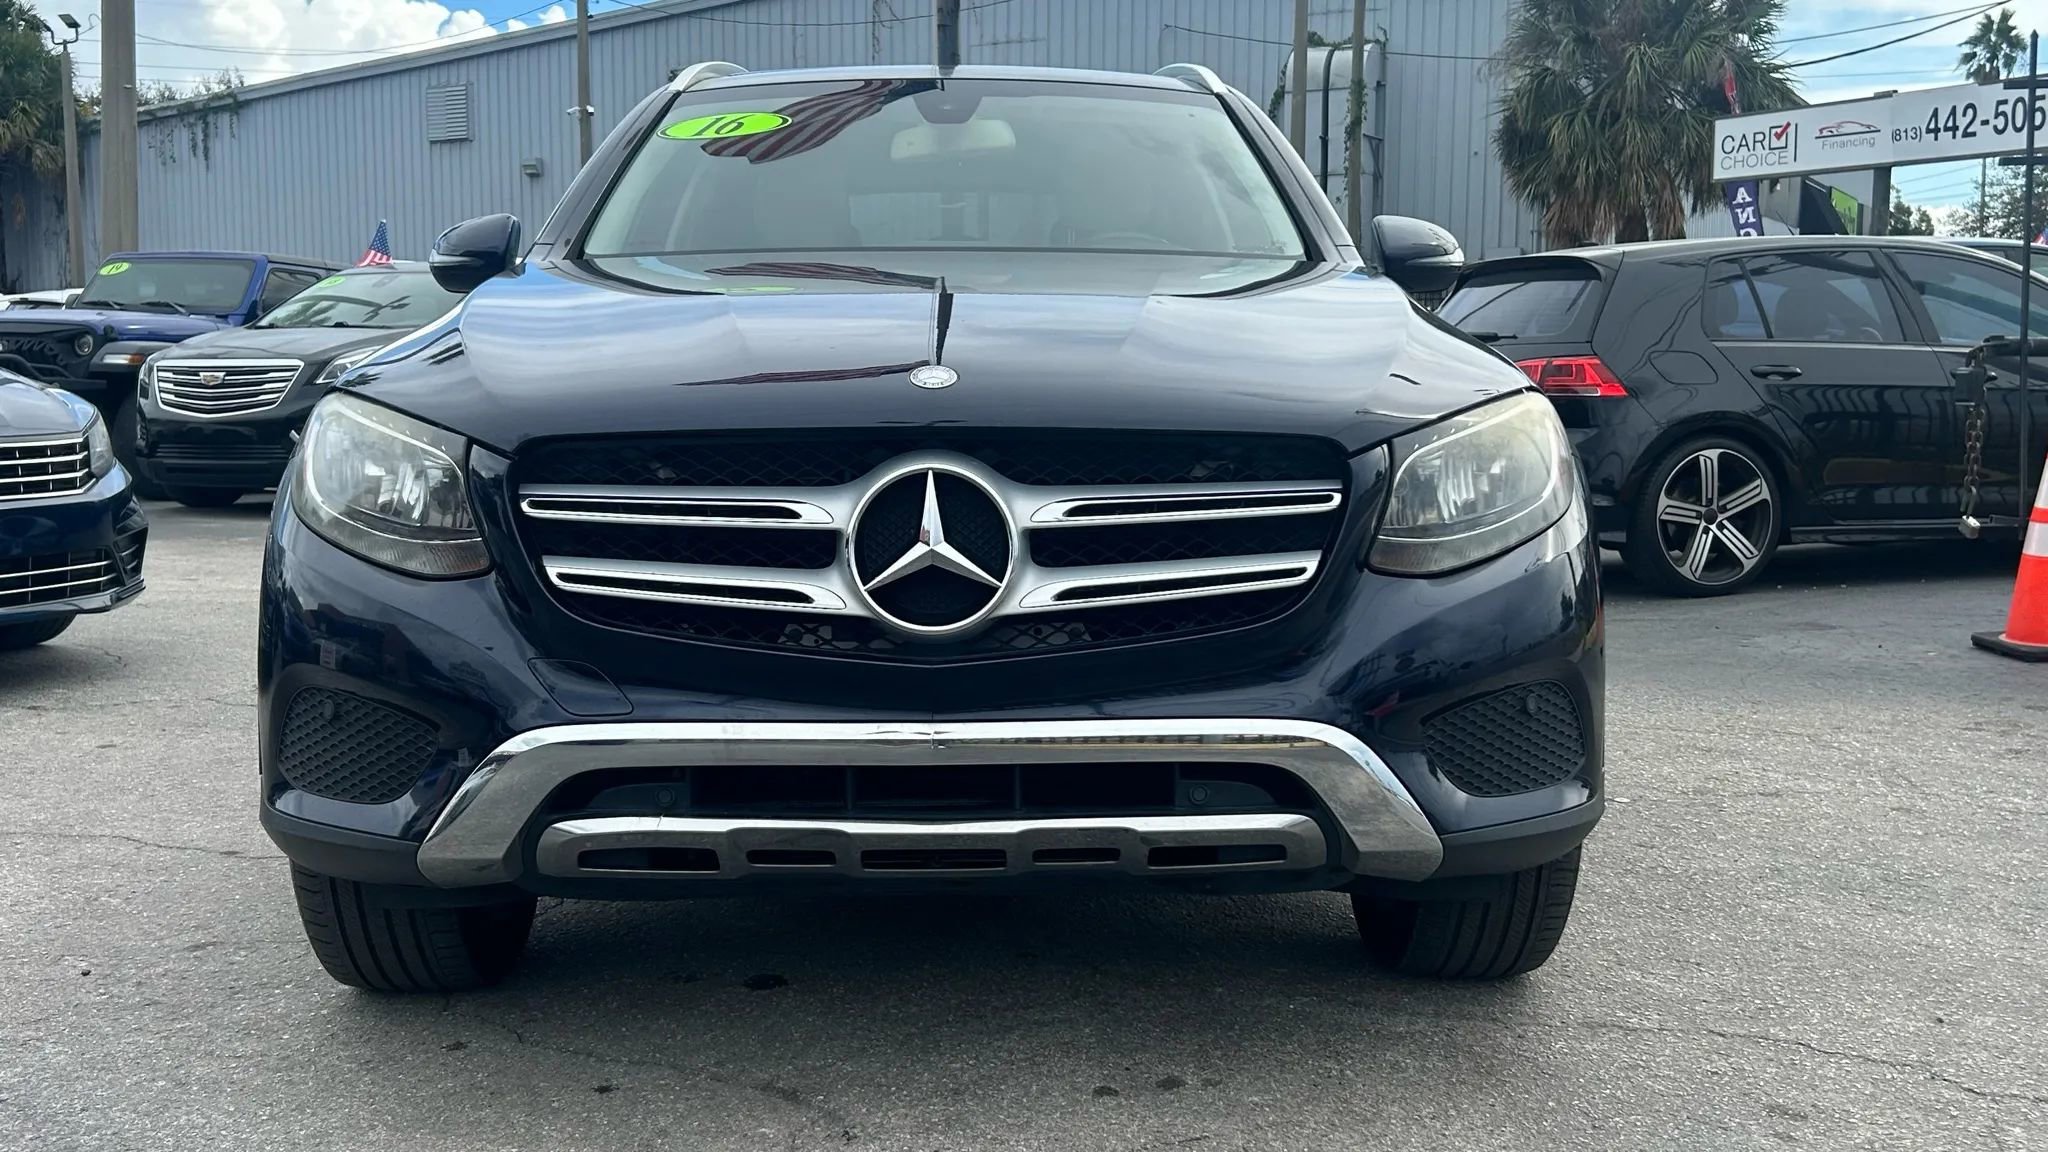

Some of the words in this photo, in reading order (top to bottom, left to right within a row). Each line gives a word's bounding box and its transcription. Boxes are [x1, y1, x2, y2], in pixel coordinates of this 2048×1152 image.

[691, 113, 756, 137] 16
[1891, 125, 1922, 144] (813)
[1721, 131, 1766, 155] CAR
[1821, 136, 1876, 150] Financing
[1720, 150, 1789, 171] CHOICE
